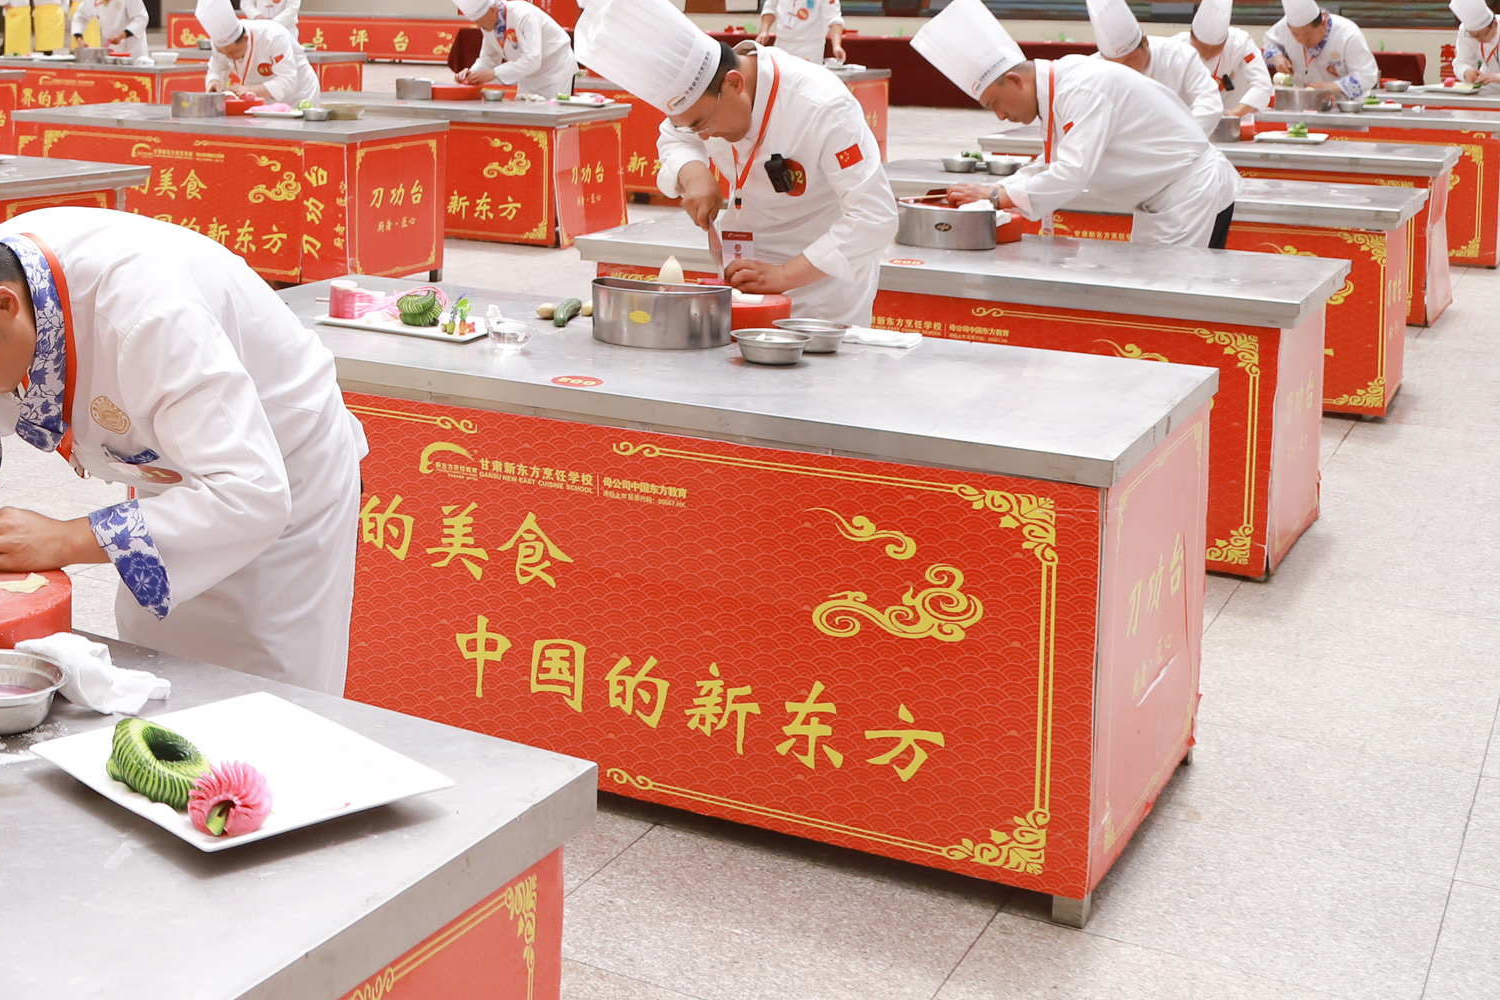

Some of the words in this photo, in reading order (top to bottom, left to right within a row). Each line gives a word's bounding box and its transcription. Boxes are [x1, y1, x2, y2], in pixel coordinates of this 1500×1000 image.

[312, 27, 410, 52] 点评台
[571, 160, 605, 186] 刀功台
[369, 179, 425, 209] 刀功台
[446, 189, 522, 222] 新东方
[478, 457, 594, 487] 甘肃新东方烹饪学校
[502, 473, 518, 483] NEW
[518, 476, 536, 486] EAST
[565, 483, 595, 495] SCHOOL
[602, 476, 688, 499] 母公司中国东方教育
[360, 493, 574, 589] 的美食
[455, 614, 946, 784] 中国的新东方
